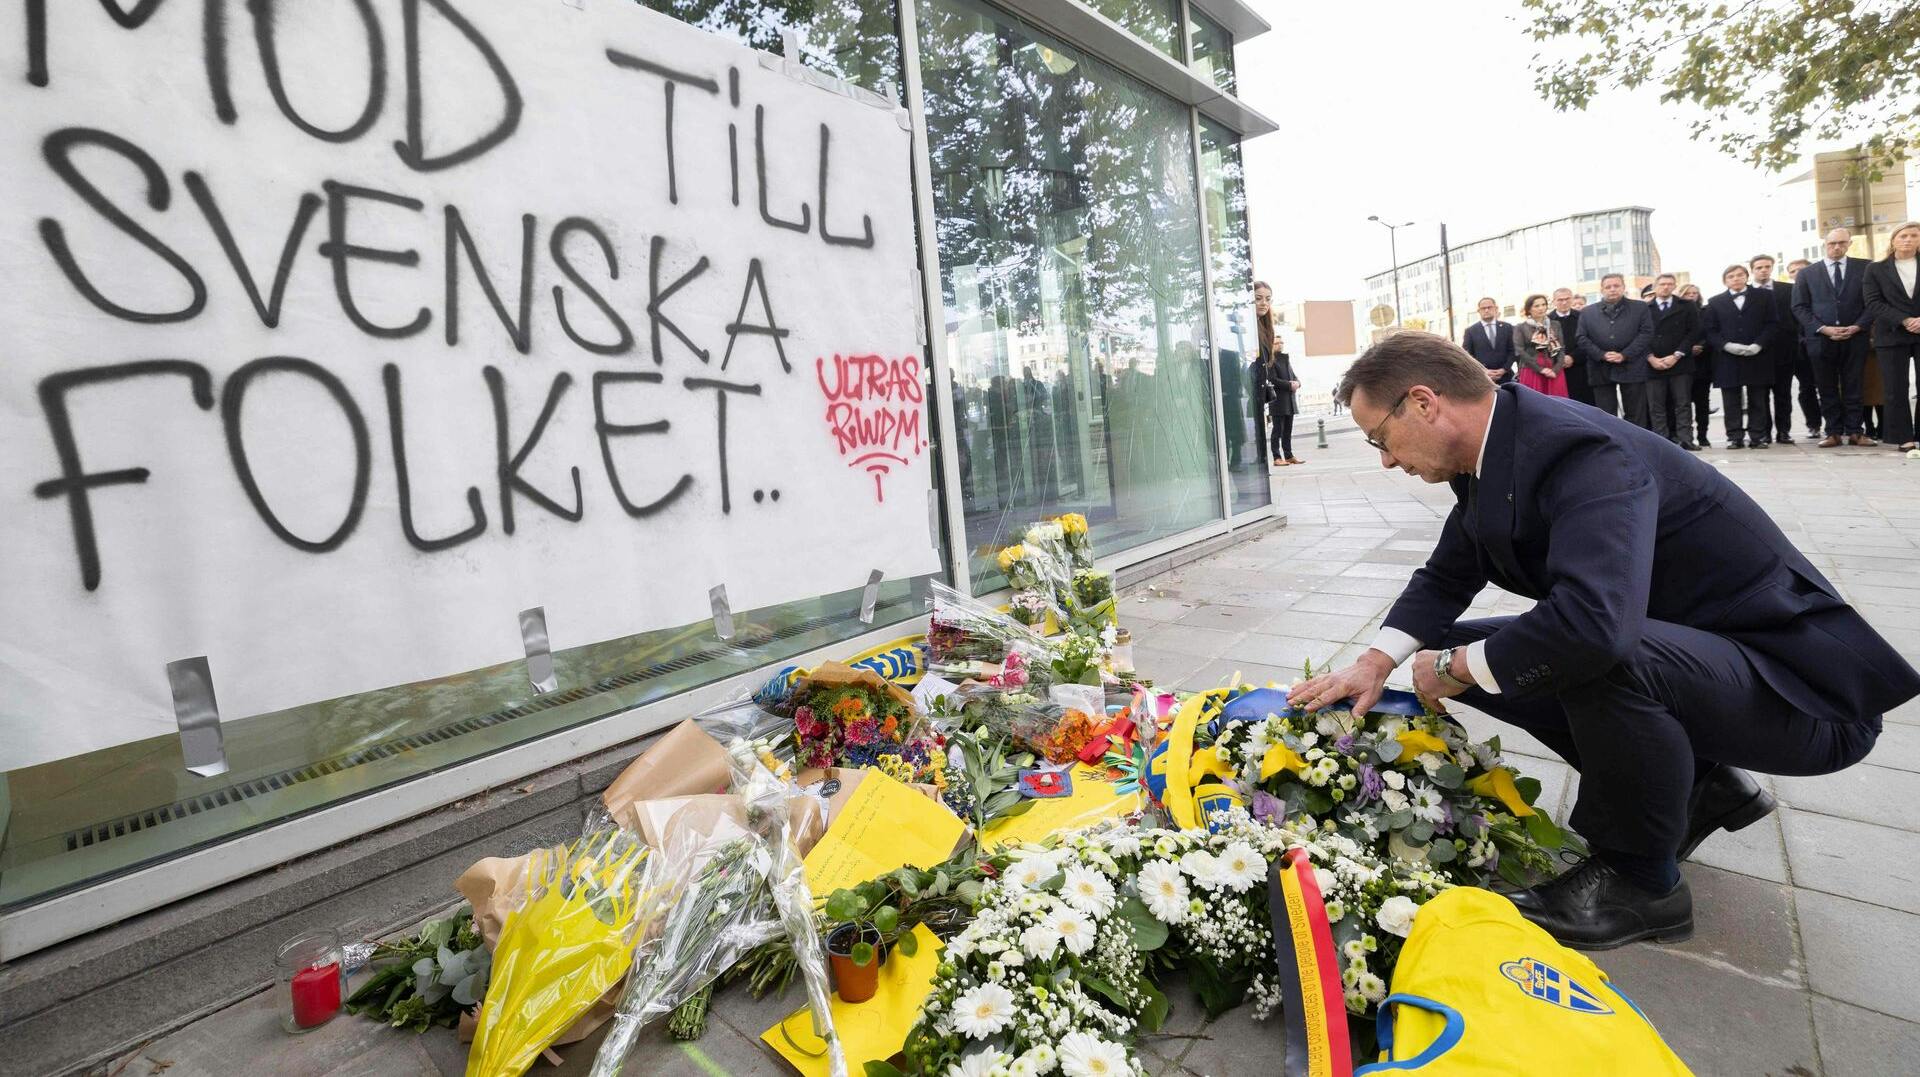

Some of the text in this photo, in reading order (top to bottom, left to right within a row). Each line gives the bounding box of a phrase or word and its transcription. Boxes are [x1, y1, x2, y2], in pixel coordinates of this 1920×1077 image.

[38, 127, 792, 373] SVENSKA
[815, 353, 923, 403] ULTRAS
[1287, 894, 1306, 929] Sweden
[1296, 940, 1317, 968] people
[1300, 968, 1315, 983] the
